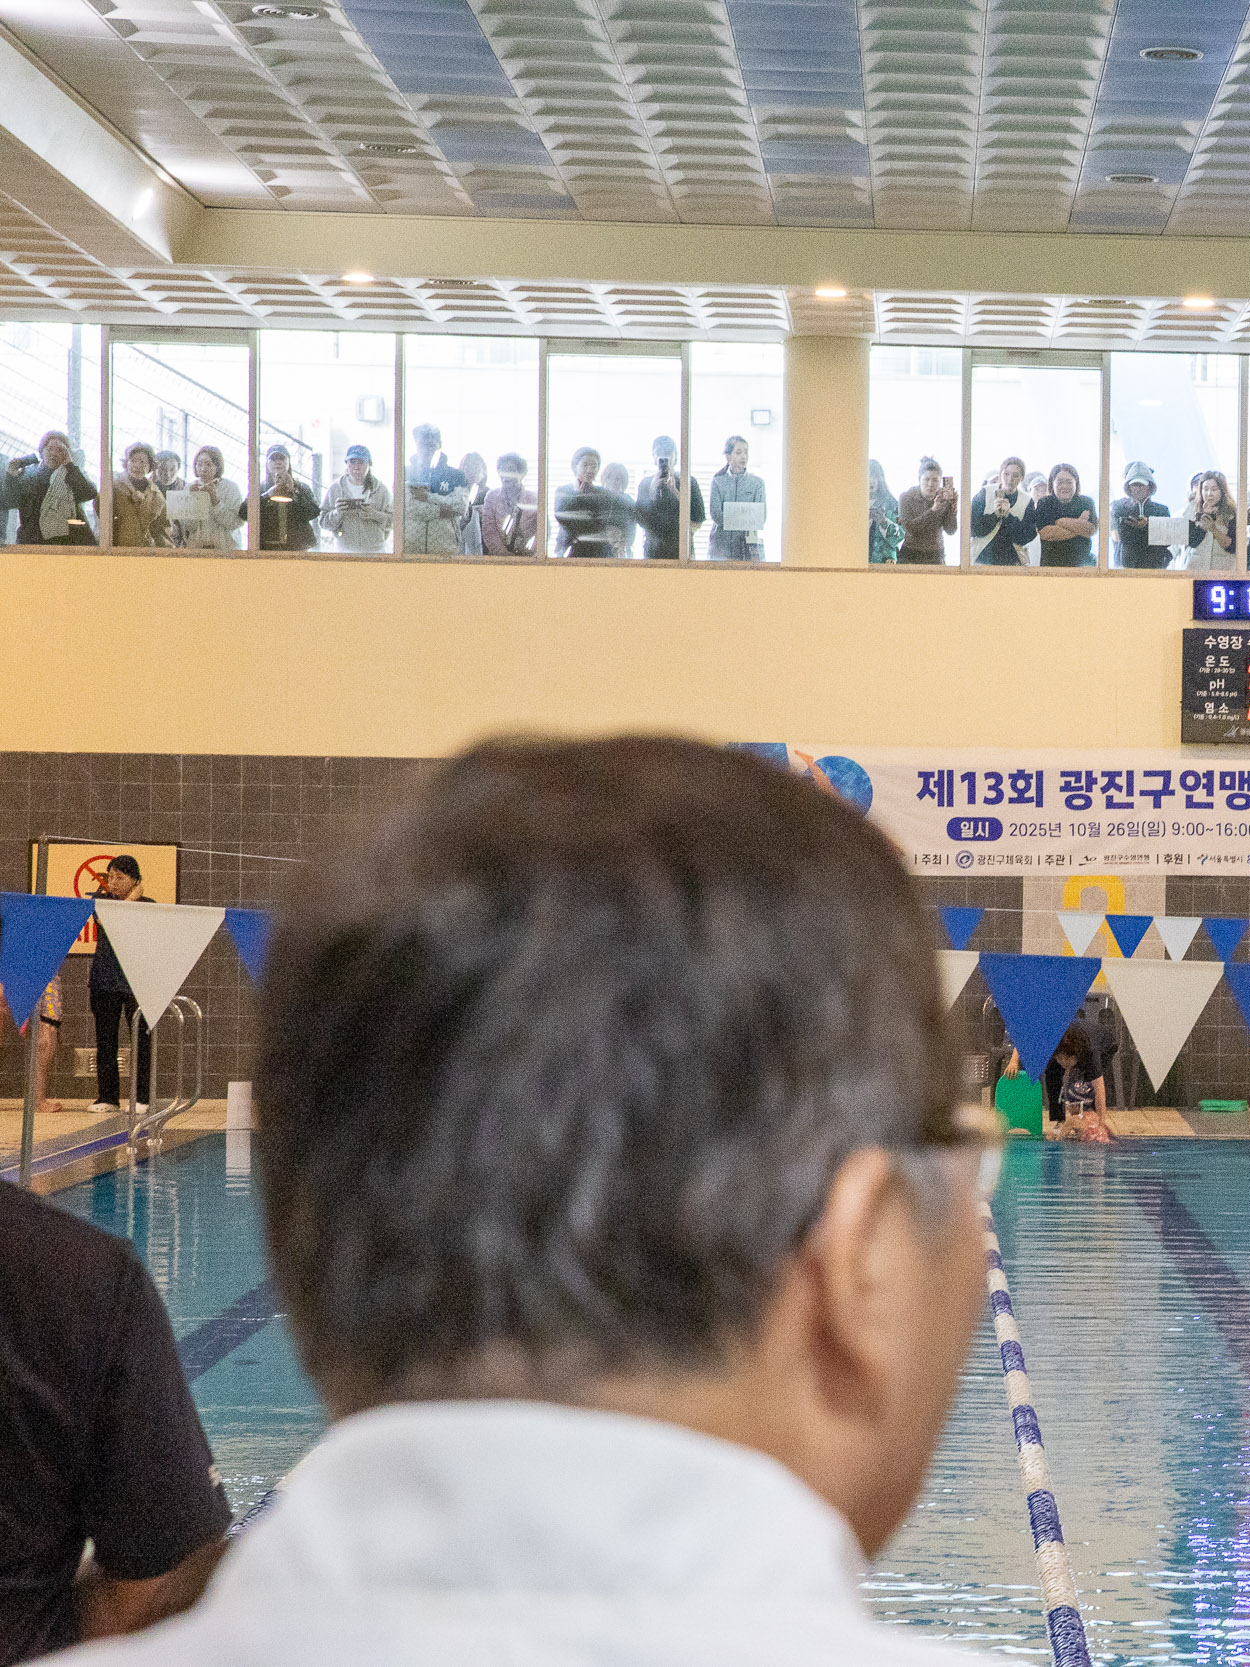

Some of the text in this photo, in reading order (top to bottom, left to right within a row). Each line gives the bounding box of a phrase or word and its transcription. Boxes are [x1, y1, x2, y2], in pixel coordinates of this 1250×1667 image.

[1204, 636, 1243, 649] 수영장
[1209, 679, 1225, 690] pH
[916, 769, 1044, 807] 제13회
[960, 821, 990, 838] 일시
[1009, 822, 1062, 837] 2025년
[1069, 822, 1101, 837] 10월
[1107, 821, 1166, 837] 26일(일)
[977, 854, 1033, 865] 광진구체육회
